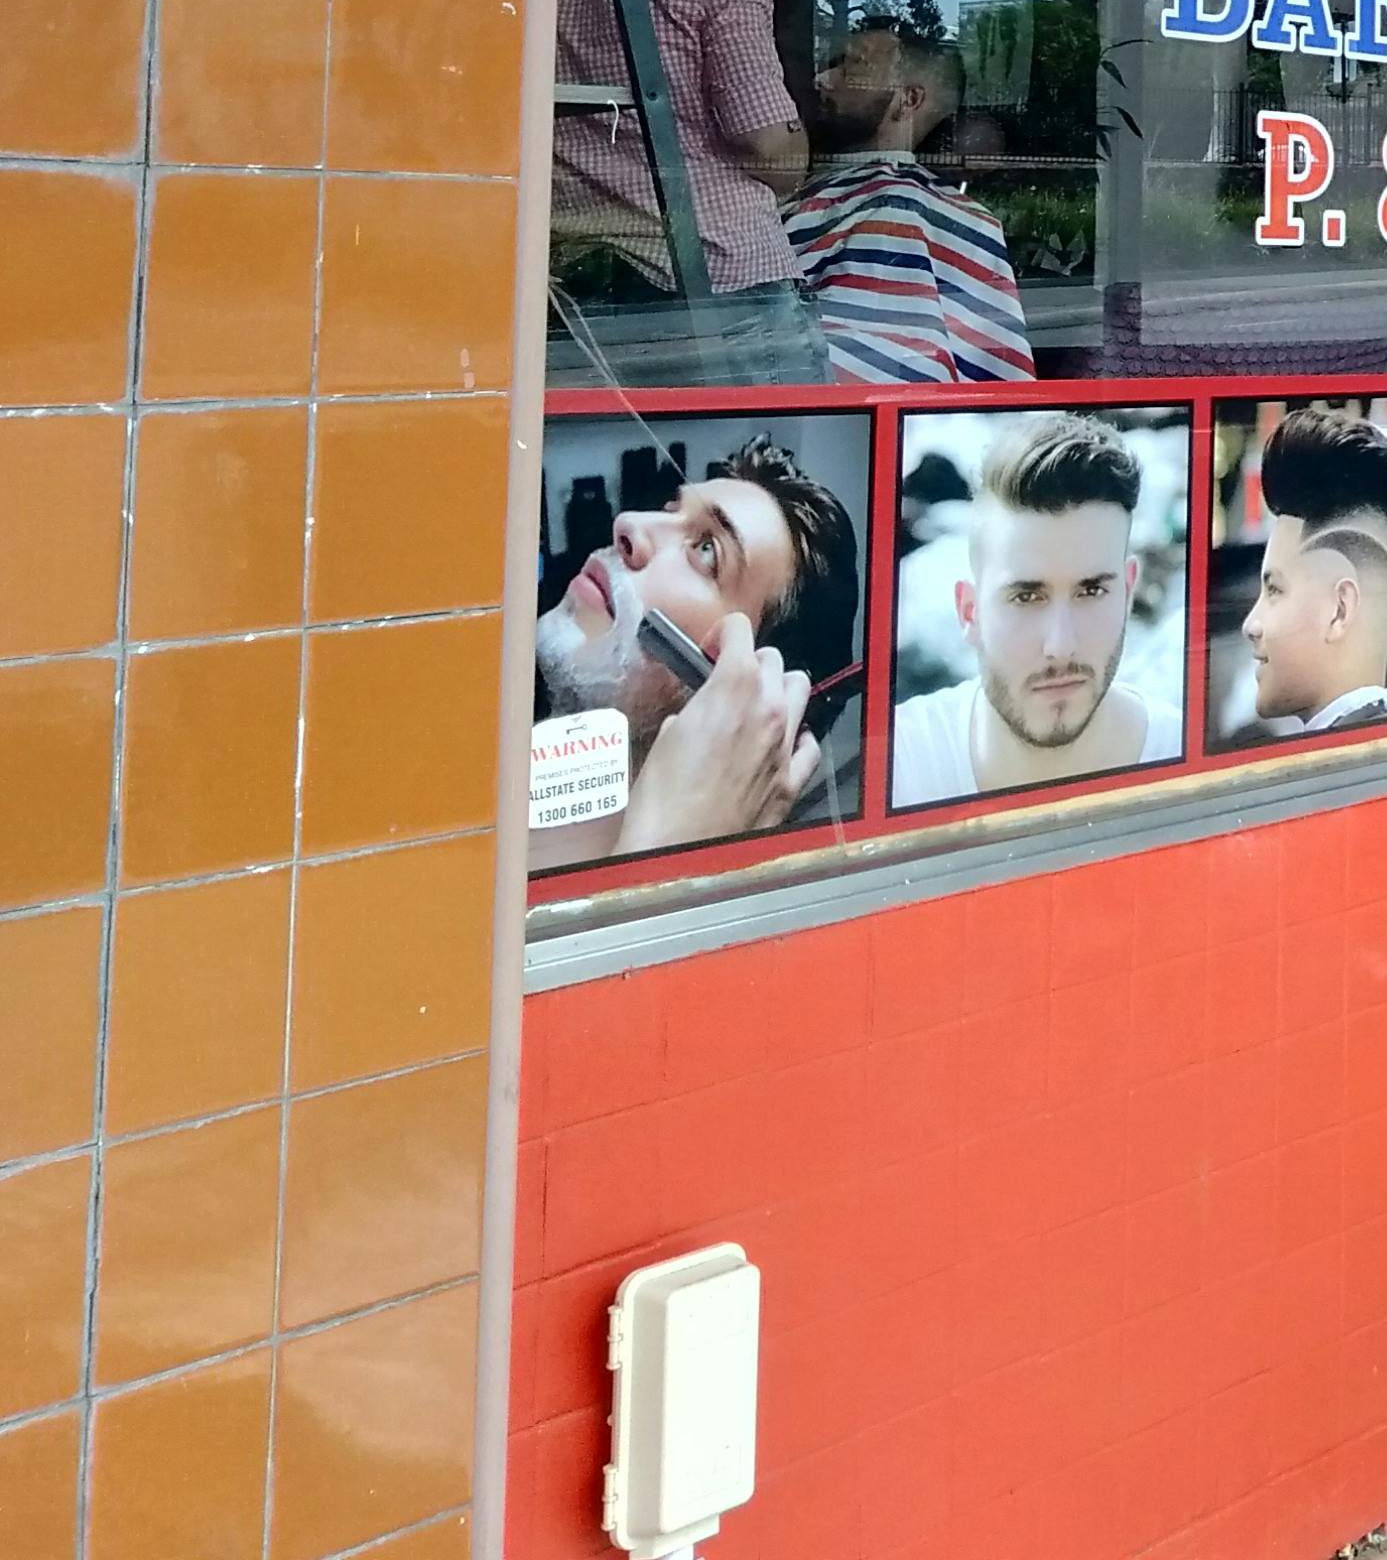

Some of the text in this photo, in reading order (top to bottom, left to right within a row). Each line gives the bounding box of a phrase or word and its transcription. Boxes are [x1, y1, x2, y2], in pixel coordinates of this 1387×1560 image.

[1255, 109, 1345, 249] P.
[531, 732, 623, 762] WARNING
[528, 771, 626, 802] ALLSTATE SECURITY
[535, 768, 568, 781] PREMISES
[538, 795, 617, 824] 1300 660 165
